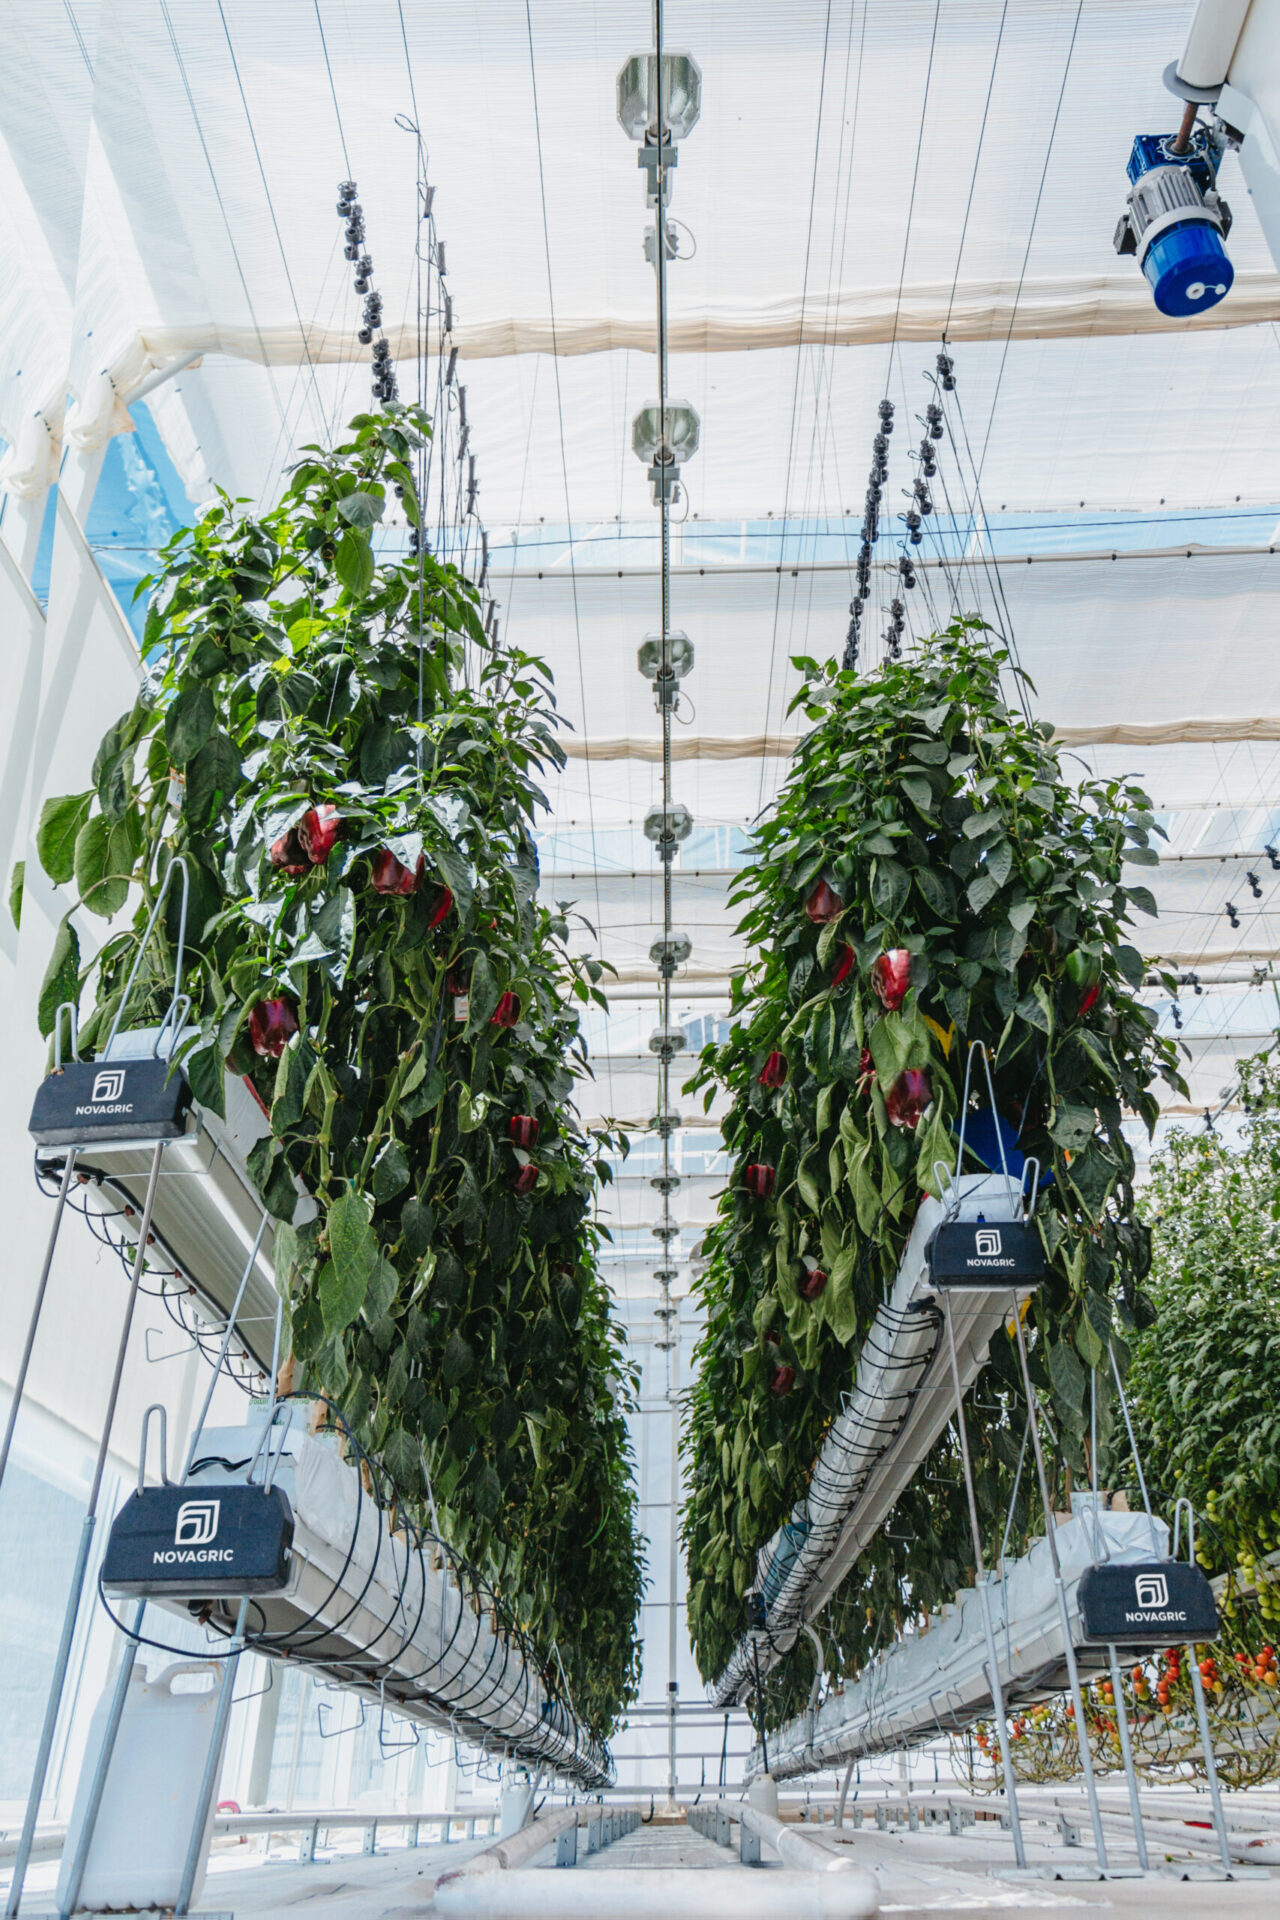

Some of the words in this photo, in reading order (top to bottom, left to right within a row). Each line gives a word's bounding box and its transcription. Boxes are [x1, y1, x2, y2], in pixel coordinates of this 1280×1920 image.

[75, 1103, 134, 1116] NOVAGRIC
[966, 1258, 1016, 1267] NOVAGRIC
[152, 1549, 234, 1564] NOVAGRIC
[1125, 1611, 1187, 1622] NOVAGRIC
